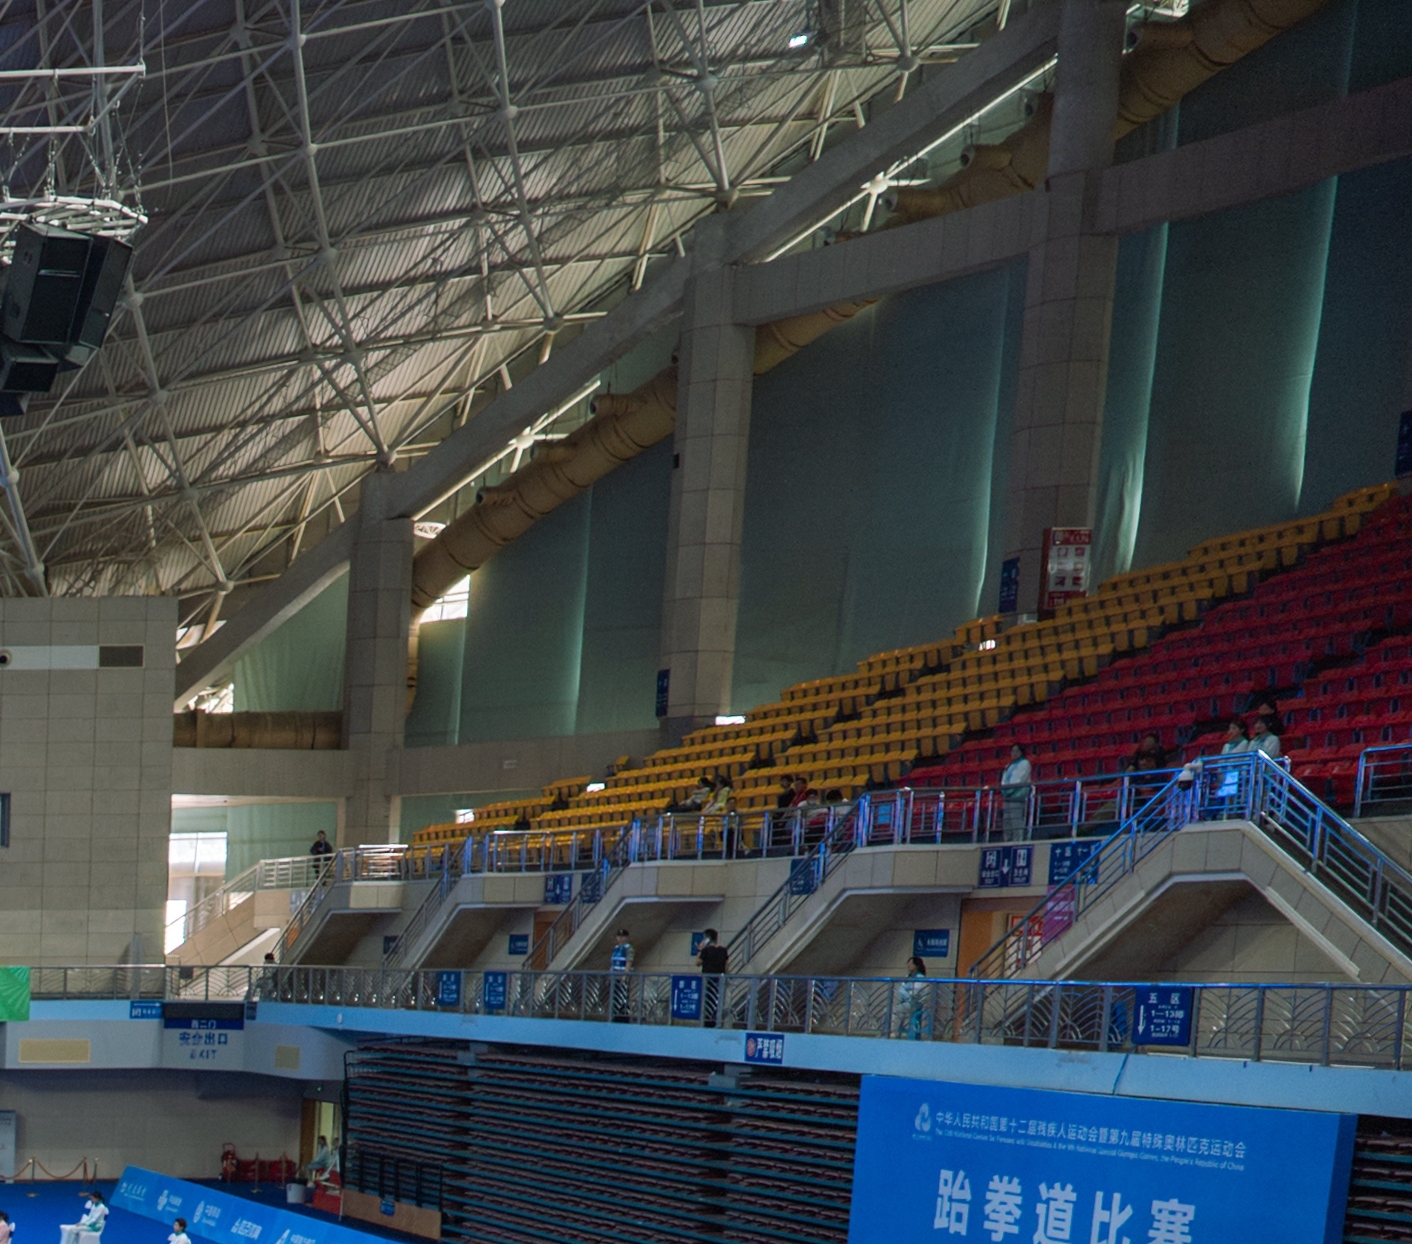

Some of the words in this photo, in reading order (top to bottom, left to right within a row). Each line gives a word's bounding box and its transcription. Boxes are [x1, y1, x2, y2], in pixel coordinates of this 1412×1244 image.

[179, 1032, 228, 1046] 安全出口
[190, 1049, 217, 1060] EXIT
